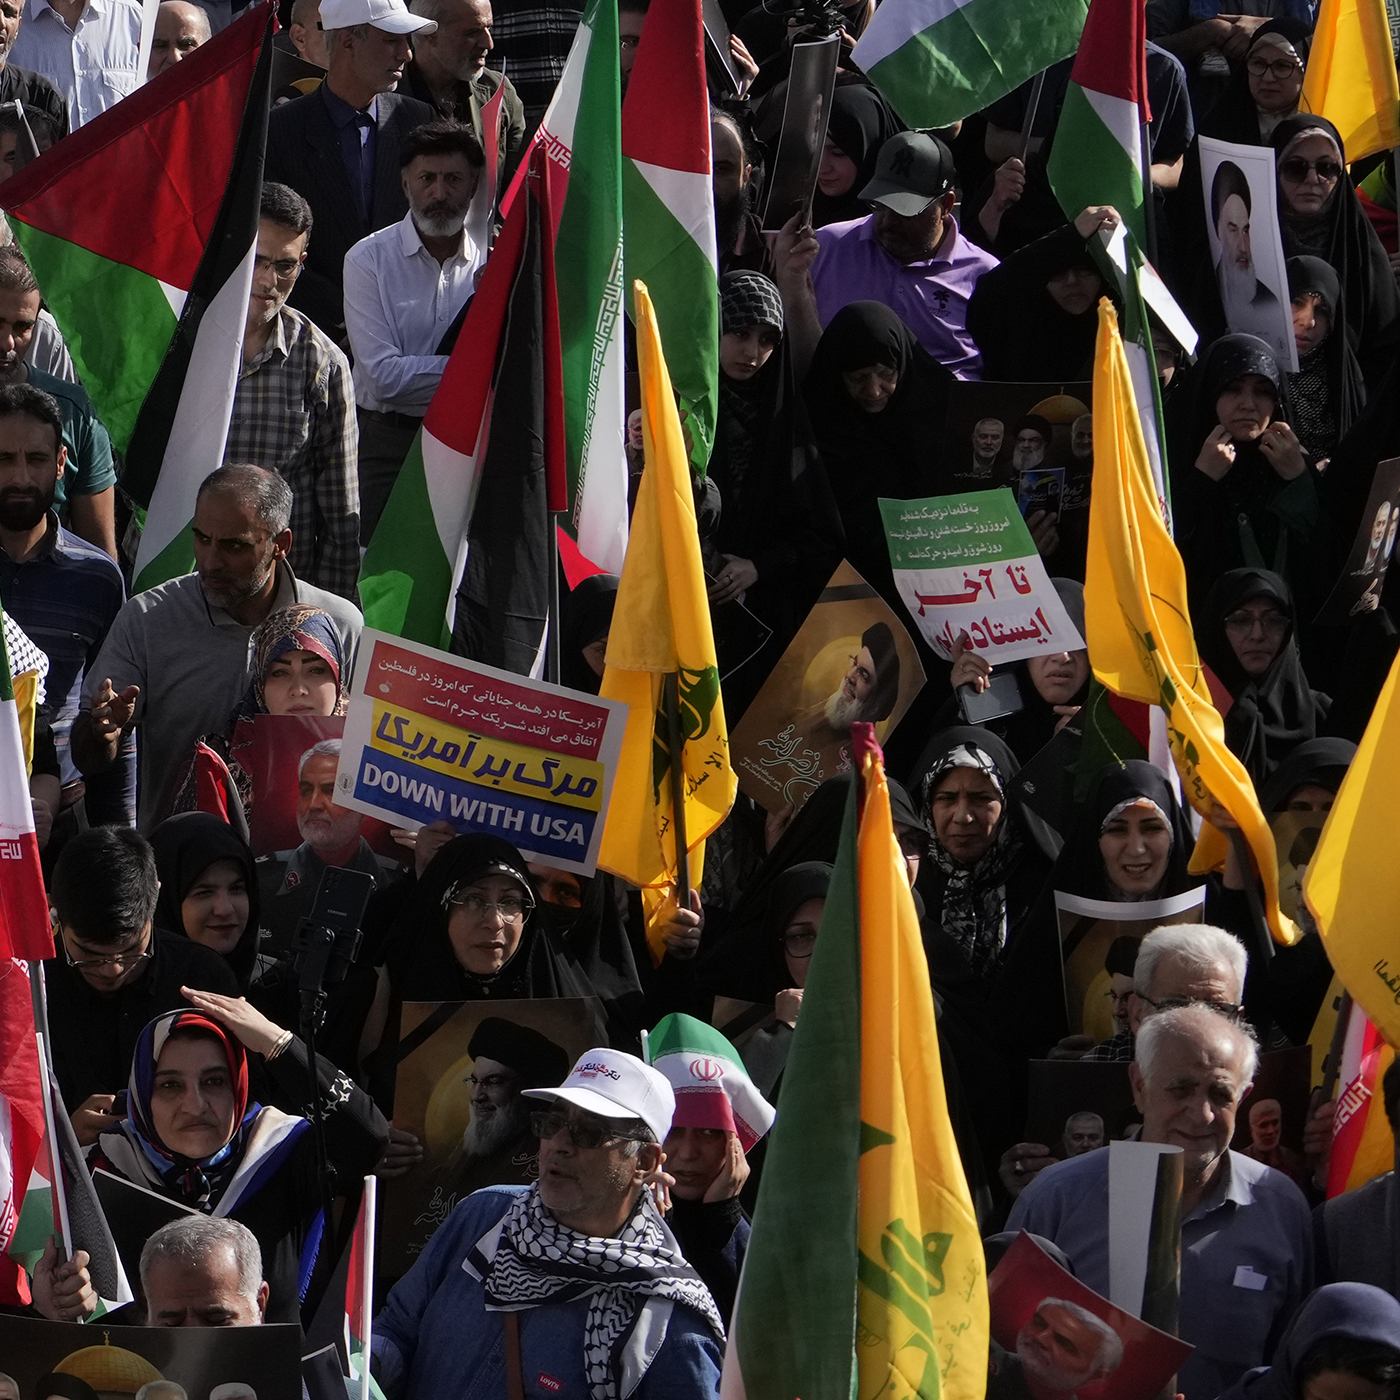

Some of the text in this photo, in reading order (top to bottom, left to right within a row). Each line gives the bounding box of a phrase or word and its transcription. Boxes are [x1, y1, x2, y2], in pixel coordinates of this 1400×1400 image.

[935, 525, 951, 538] شدن
[951, 523, 974, 534] خسته
[975, 522, 989, 534] روز
[988, 517, 1011, 531] امروز
[987, 542, 1003, 553] روز
[914, 564, 1032, 617] تا آخر
[378, 658, 603, 730] آمریکا در همه جنایاتی که امروز در فلسطین
[450, 703, 479, 720] جرم
[481, 712, 526, 731] شریک
[528, 723, 550, 737] افتد
[550, 731, 568, 743] می
[570, 732, 598, 748] اتفاق
[375, 711, 598, 798] مرگ بر آمریکا
[362, 762, 586, 846] DOWN WITH USA
